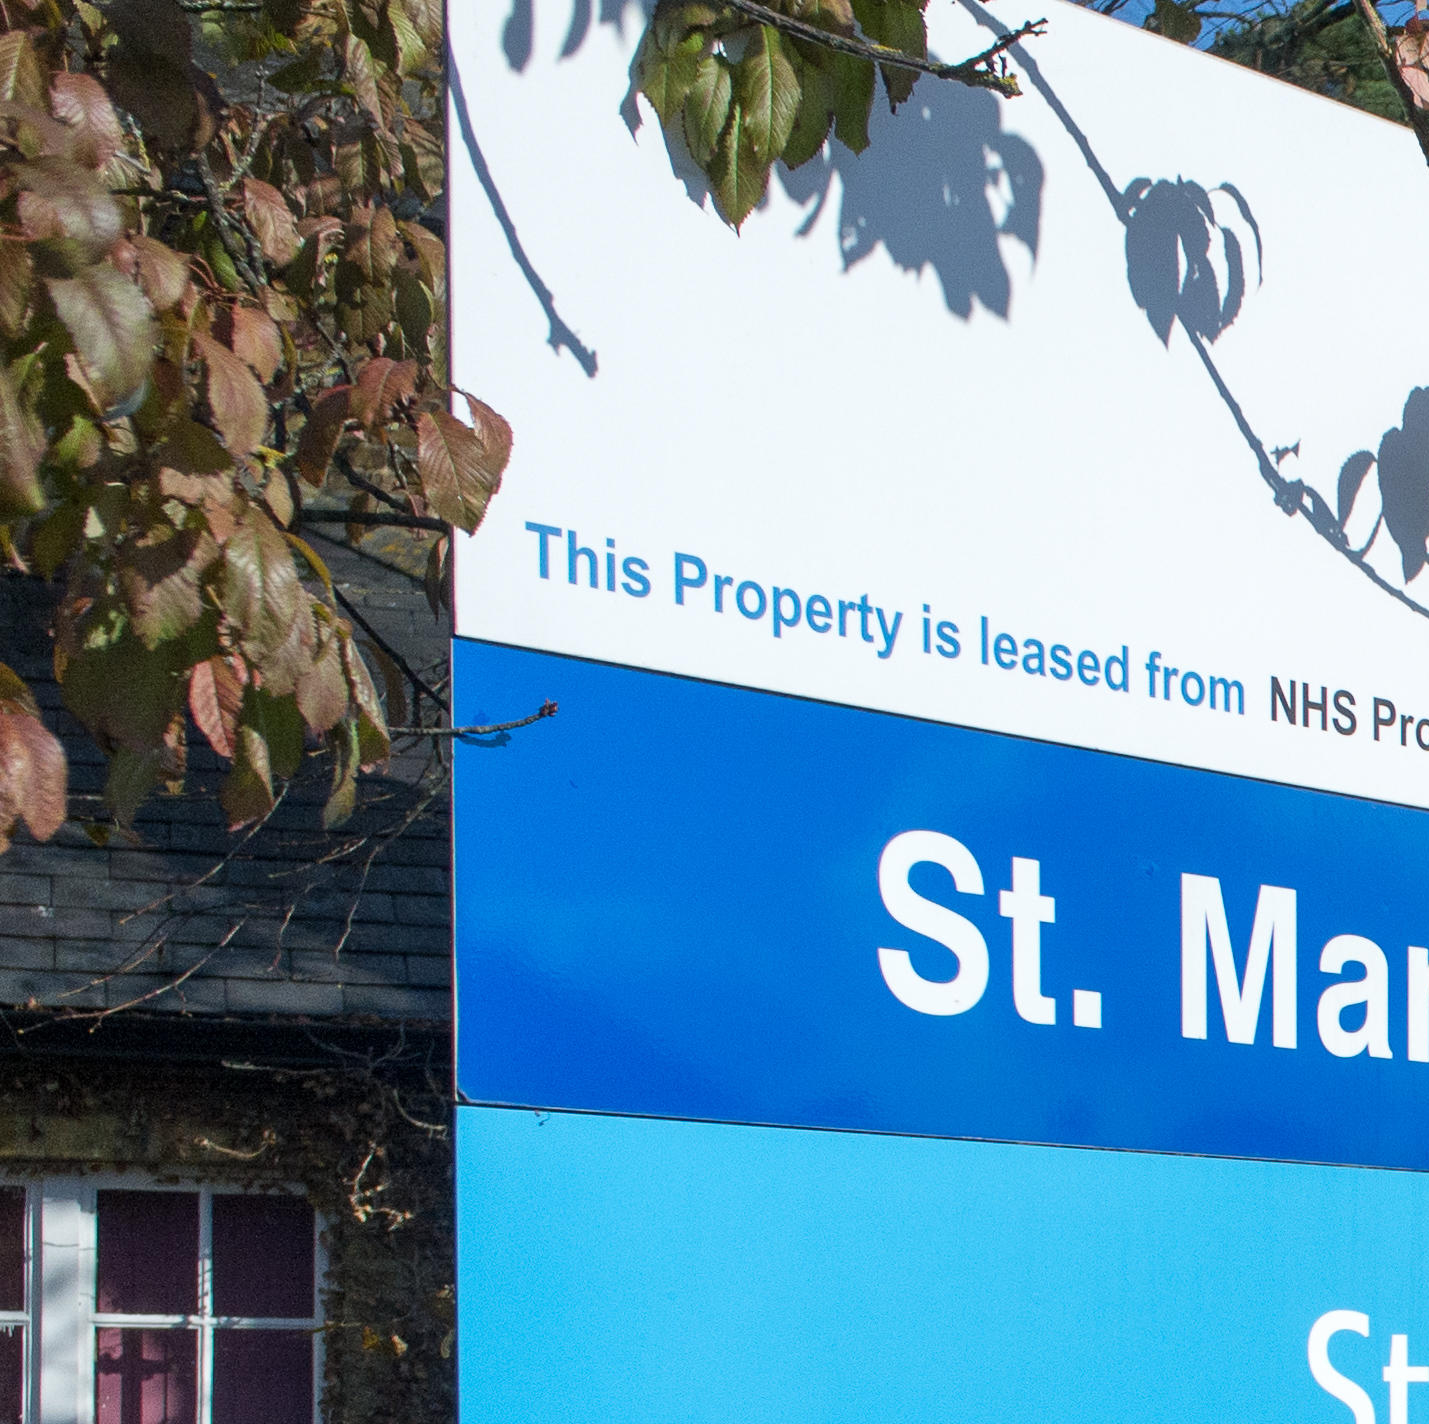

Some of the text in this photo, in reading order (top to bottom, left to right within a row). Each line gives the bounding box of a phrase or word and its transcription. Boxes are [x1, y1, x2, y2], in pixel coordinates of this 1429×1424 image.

[525, 522, 652, 597] This
[674, 551, 903, 660] Property
[922, 603, 961, 659] is
[981, 616, 1130, 693] leased
[1146, 650, 1245, 716] from
[1270, 676, 1357, 735] NHS
[877, 829, 1103, 1030] St.
